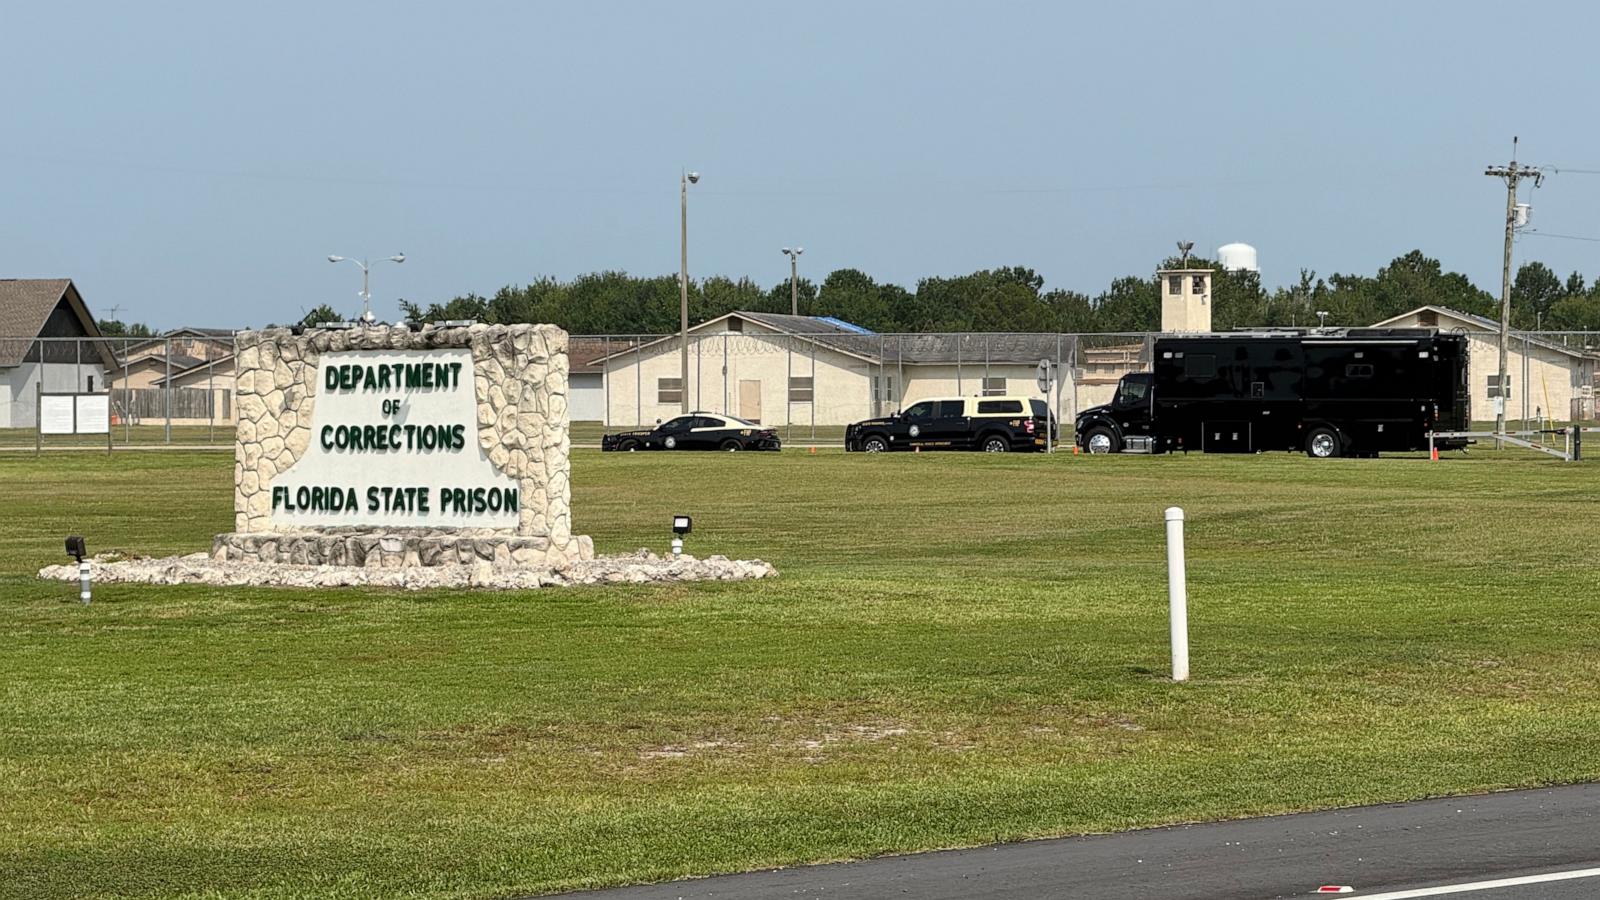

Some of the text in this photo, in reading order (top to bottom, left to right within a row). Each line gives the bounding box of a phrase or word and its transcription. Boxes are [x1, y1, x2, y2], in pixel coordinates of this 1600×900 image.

[325, 362, 462, 391] DEPARTMENT
[383, 399, 401, 416] OF
[320, 424, 465, 451] CORRECTIONS
[271, 486, 518, 514] FLORIDA STATE PRISON
